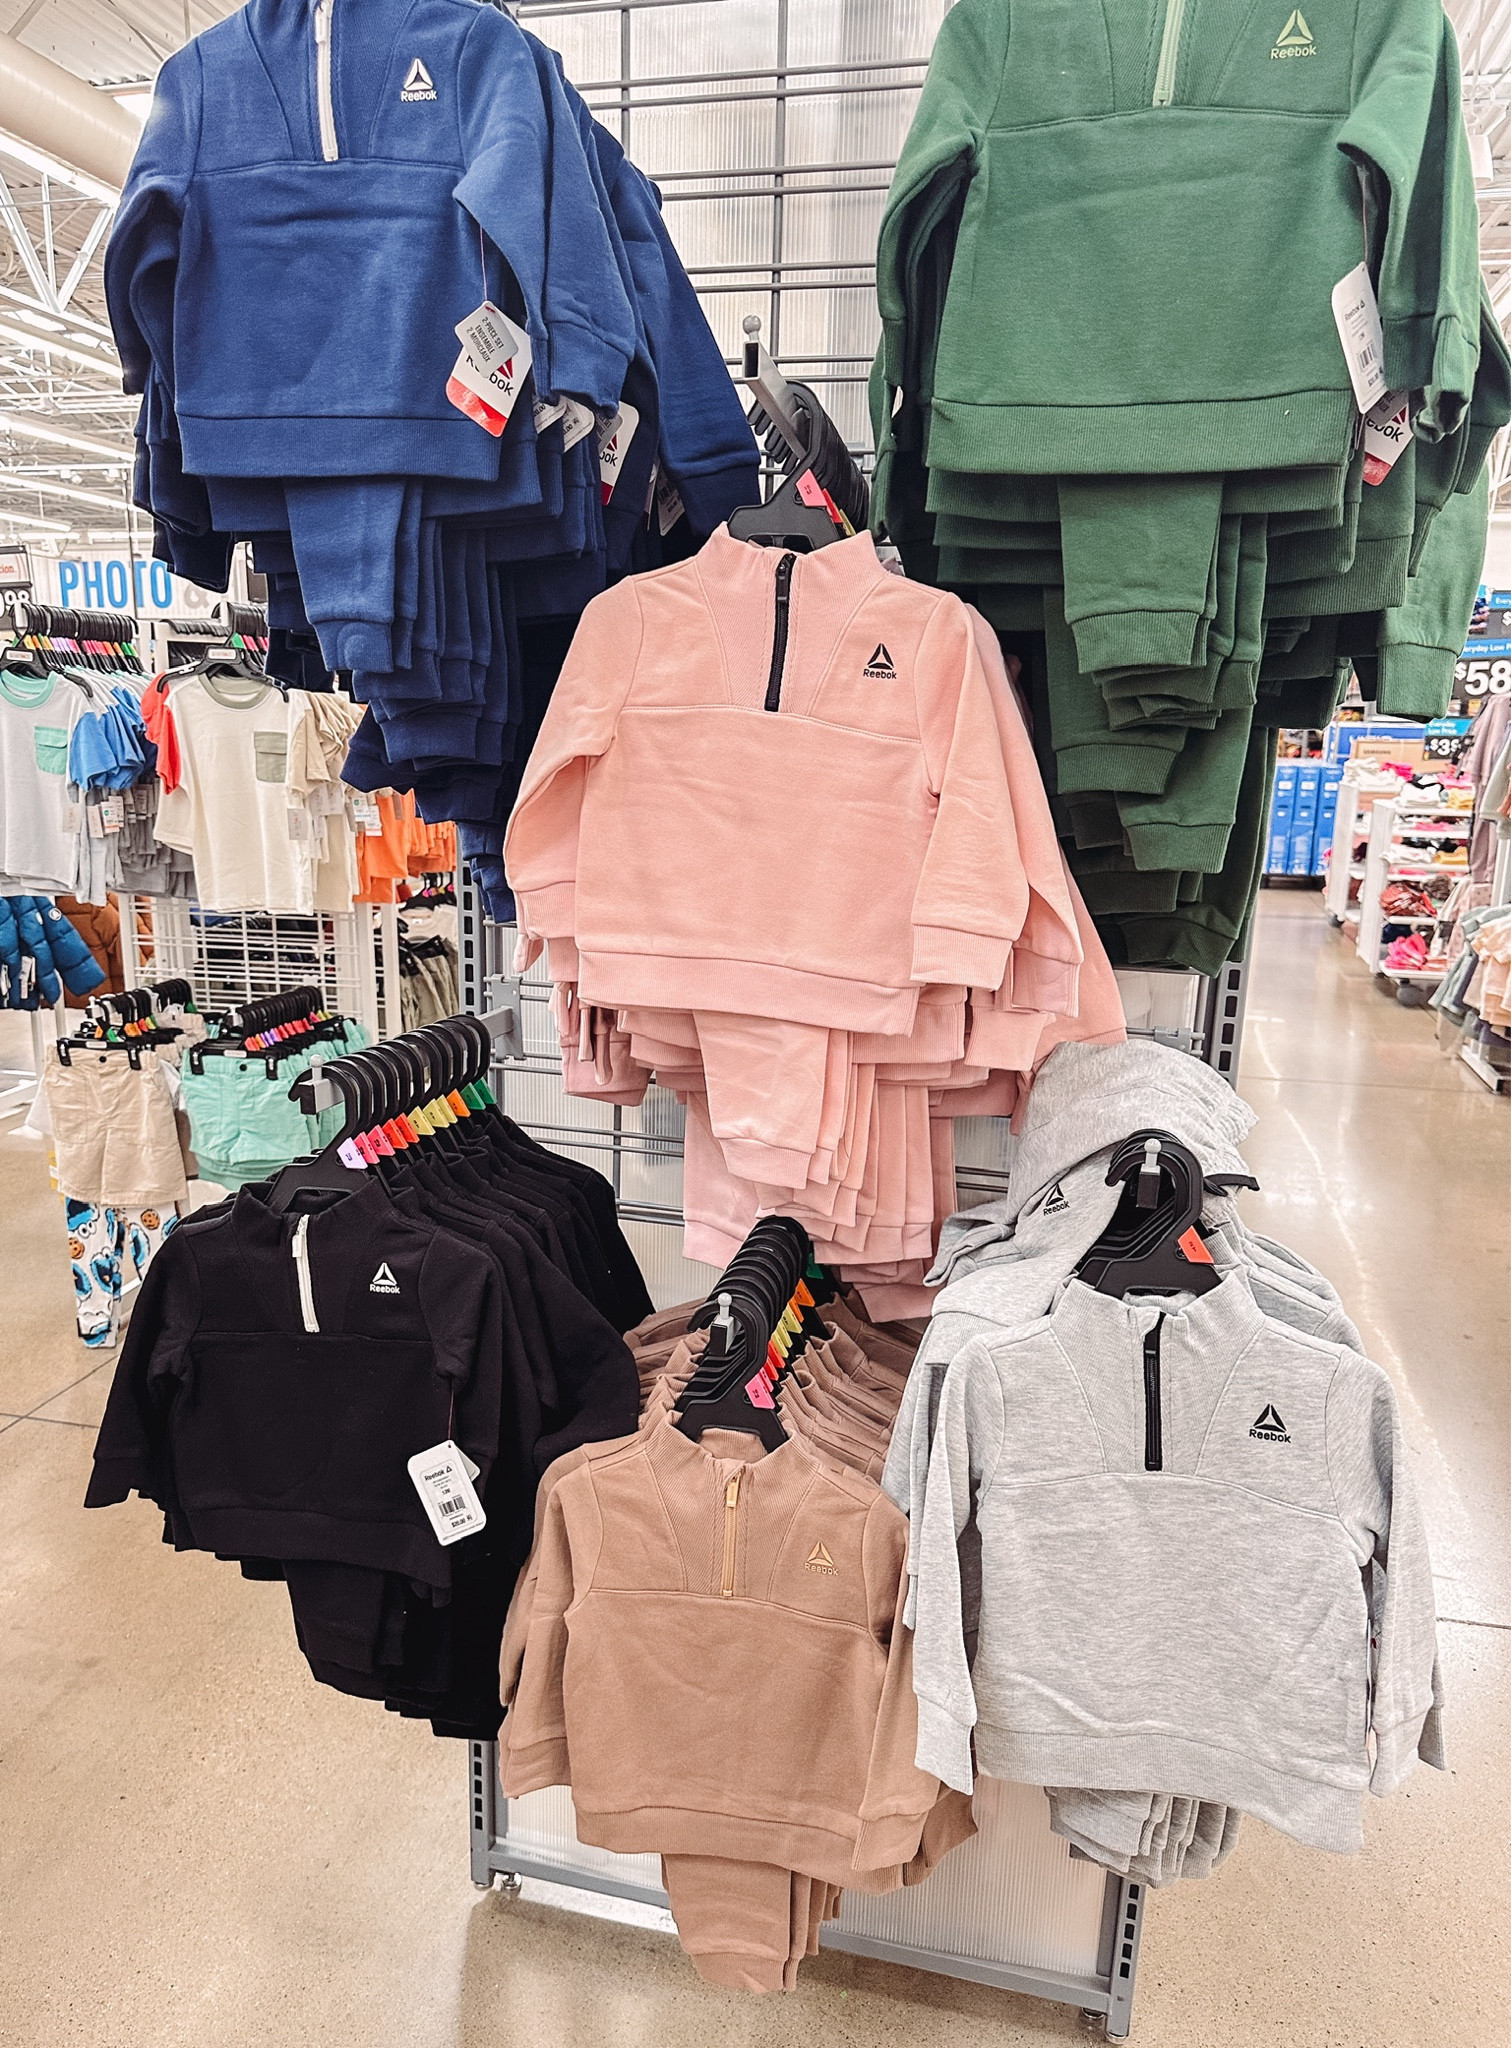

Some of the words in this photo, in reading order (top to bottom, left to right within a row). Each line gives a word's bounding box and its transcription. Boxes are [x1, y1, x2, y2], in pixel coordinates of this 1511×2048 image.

[1270, 44, 1317, 60] Reebok
[400, 90, 438, 102] Reebok
[474, 324, 496, 355] ENSEMBLE
[494, 335, 505, 350] SET
[58, 560, 173, 609] PHOTO
[862, 668, 897, 680] Reebok
[1043, 1200, 1070, 1216] Reebok
[369, 1283, 401, 1295] Reebok
[1248, 1428, 1291, 1444] Reebok
[424, 1470, 444, 1481] Reebok
[804, 1562, 839, 1576] Reebok
